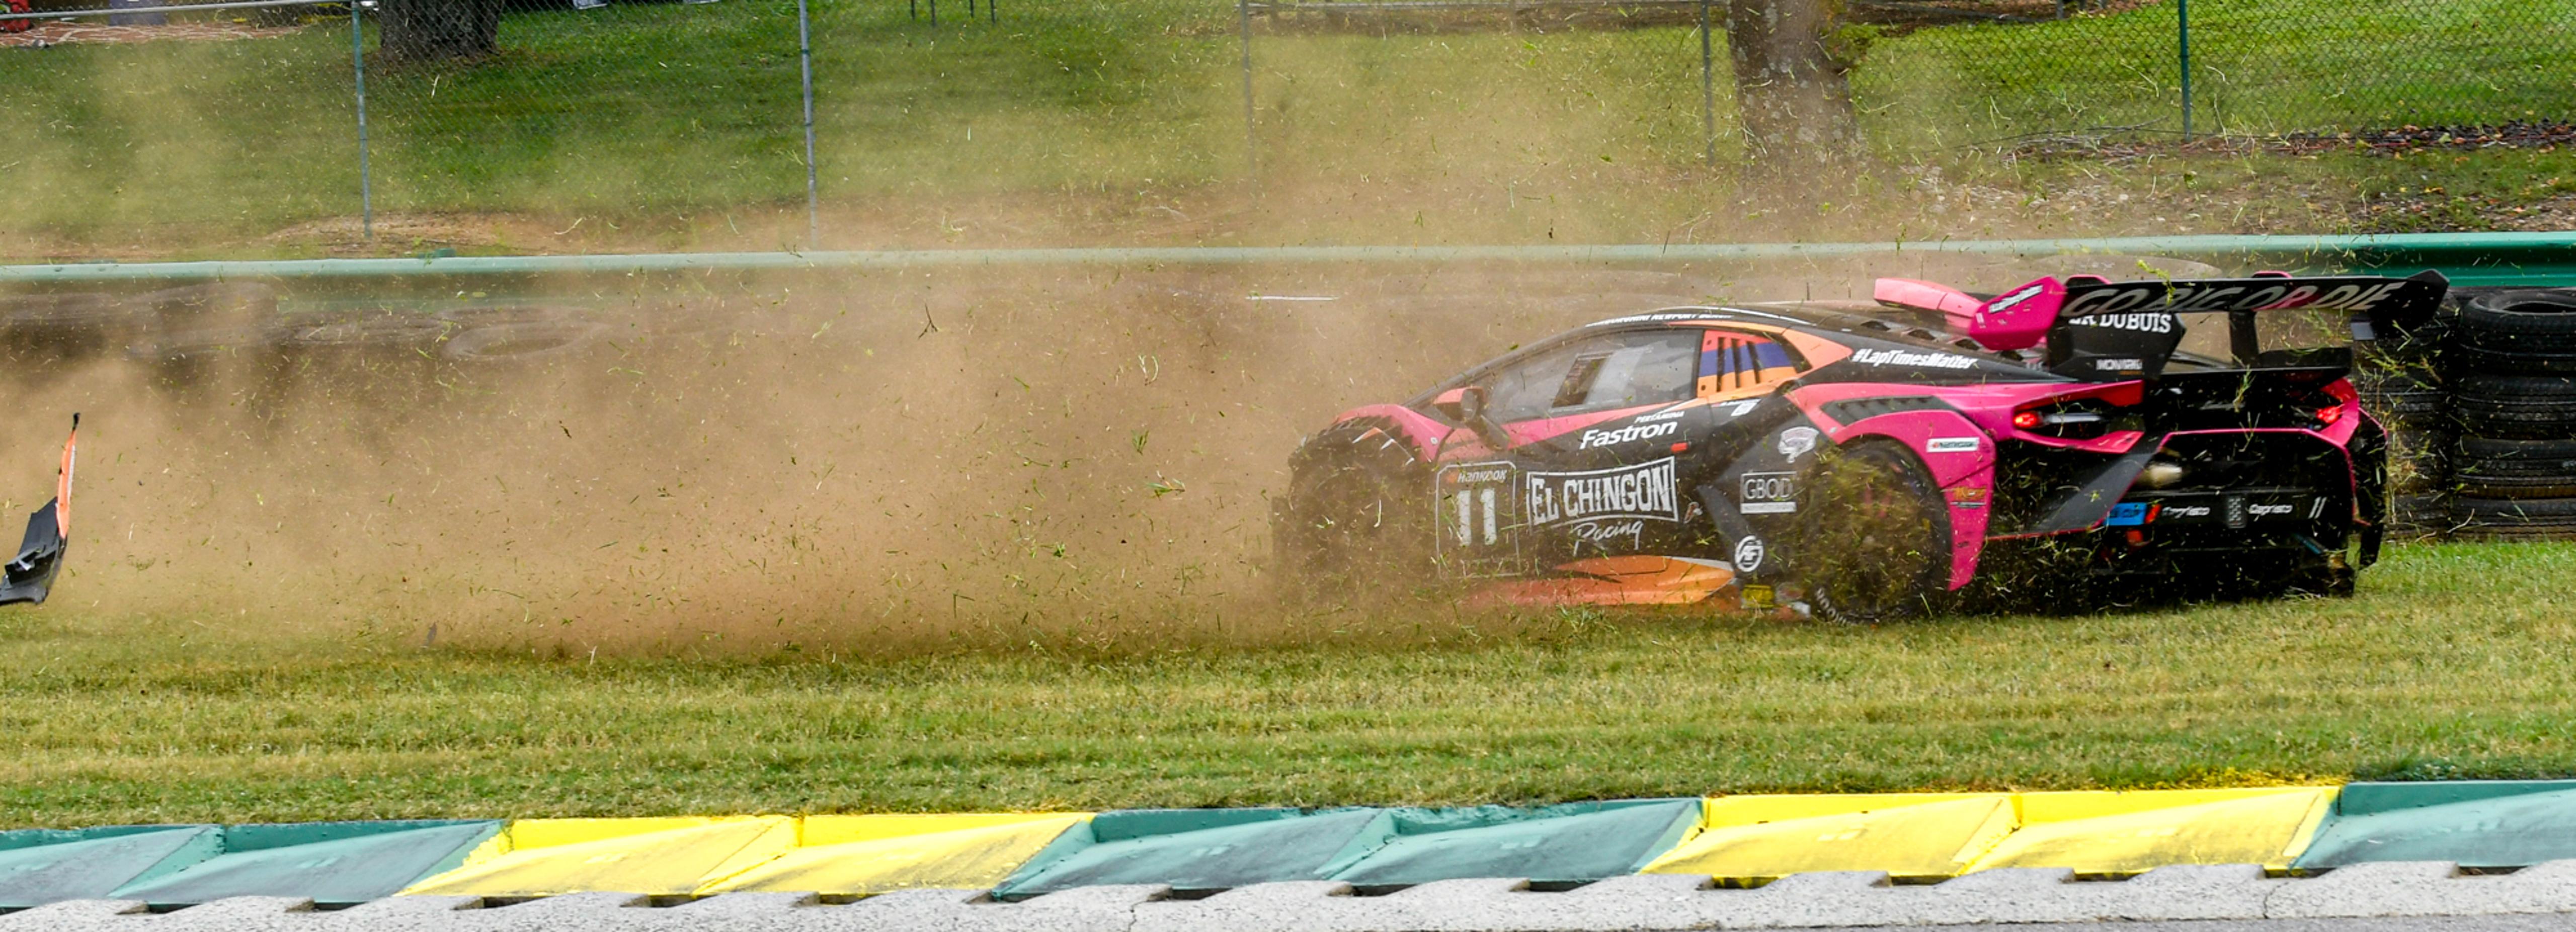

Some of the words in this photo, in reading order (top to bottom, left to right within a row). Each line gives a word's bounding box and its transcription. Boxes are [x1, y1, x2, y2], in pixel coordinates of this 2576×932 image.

[2298, 281, 2407, 311] DIE
[2100, 312, 2172, 333] DUBUIS
[1852, 349, 1979, 369] #LapTimesMatter
[1579, 421, 1678, 450] Fastron
[1563, 464, 1673, 519] CHINGON
[1744, 478, 1794, 499] GBOD
[1456, 488, 1498, 547] 11
[1572, 520, 1645, 556] Racing
